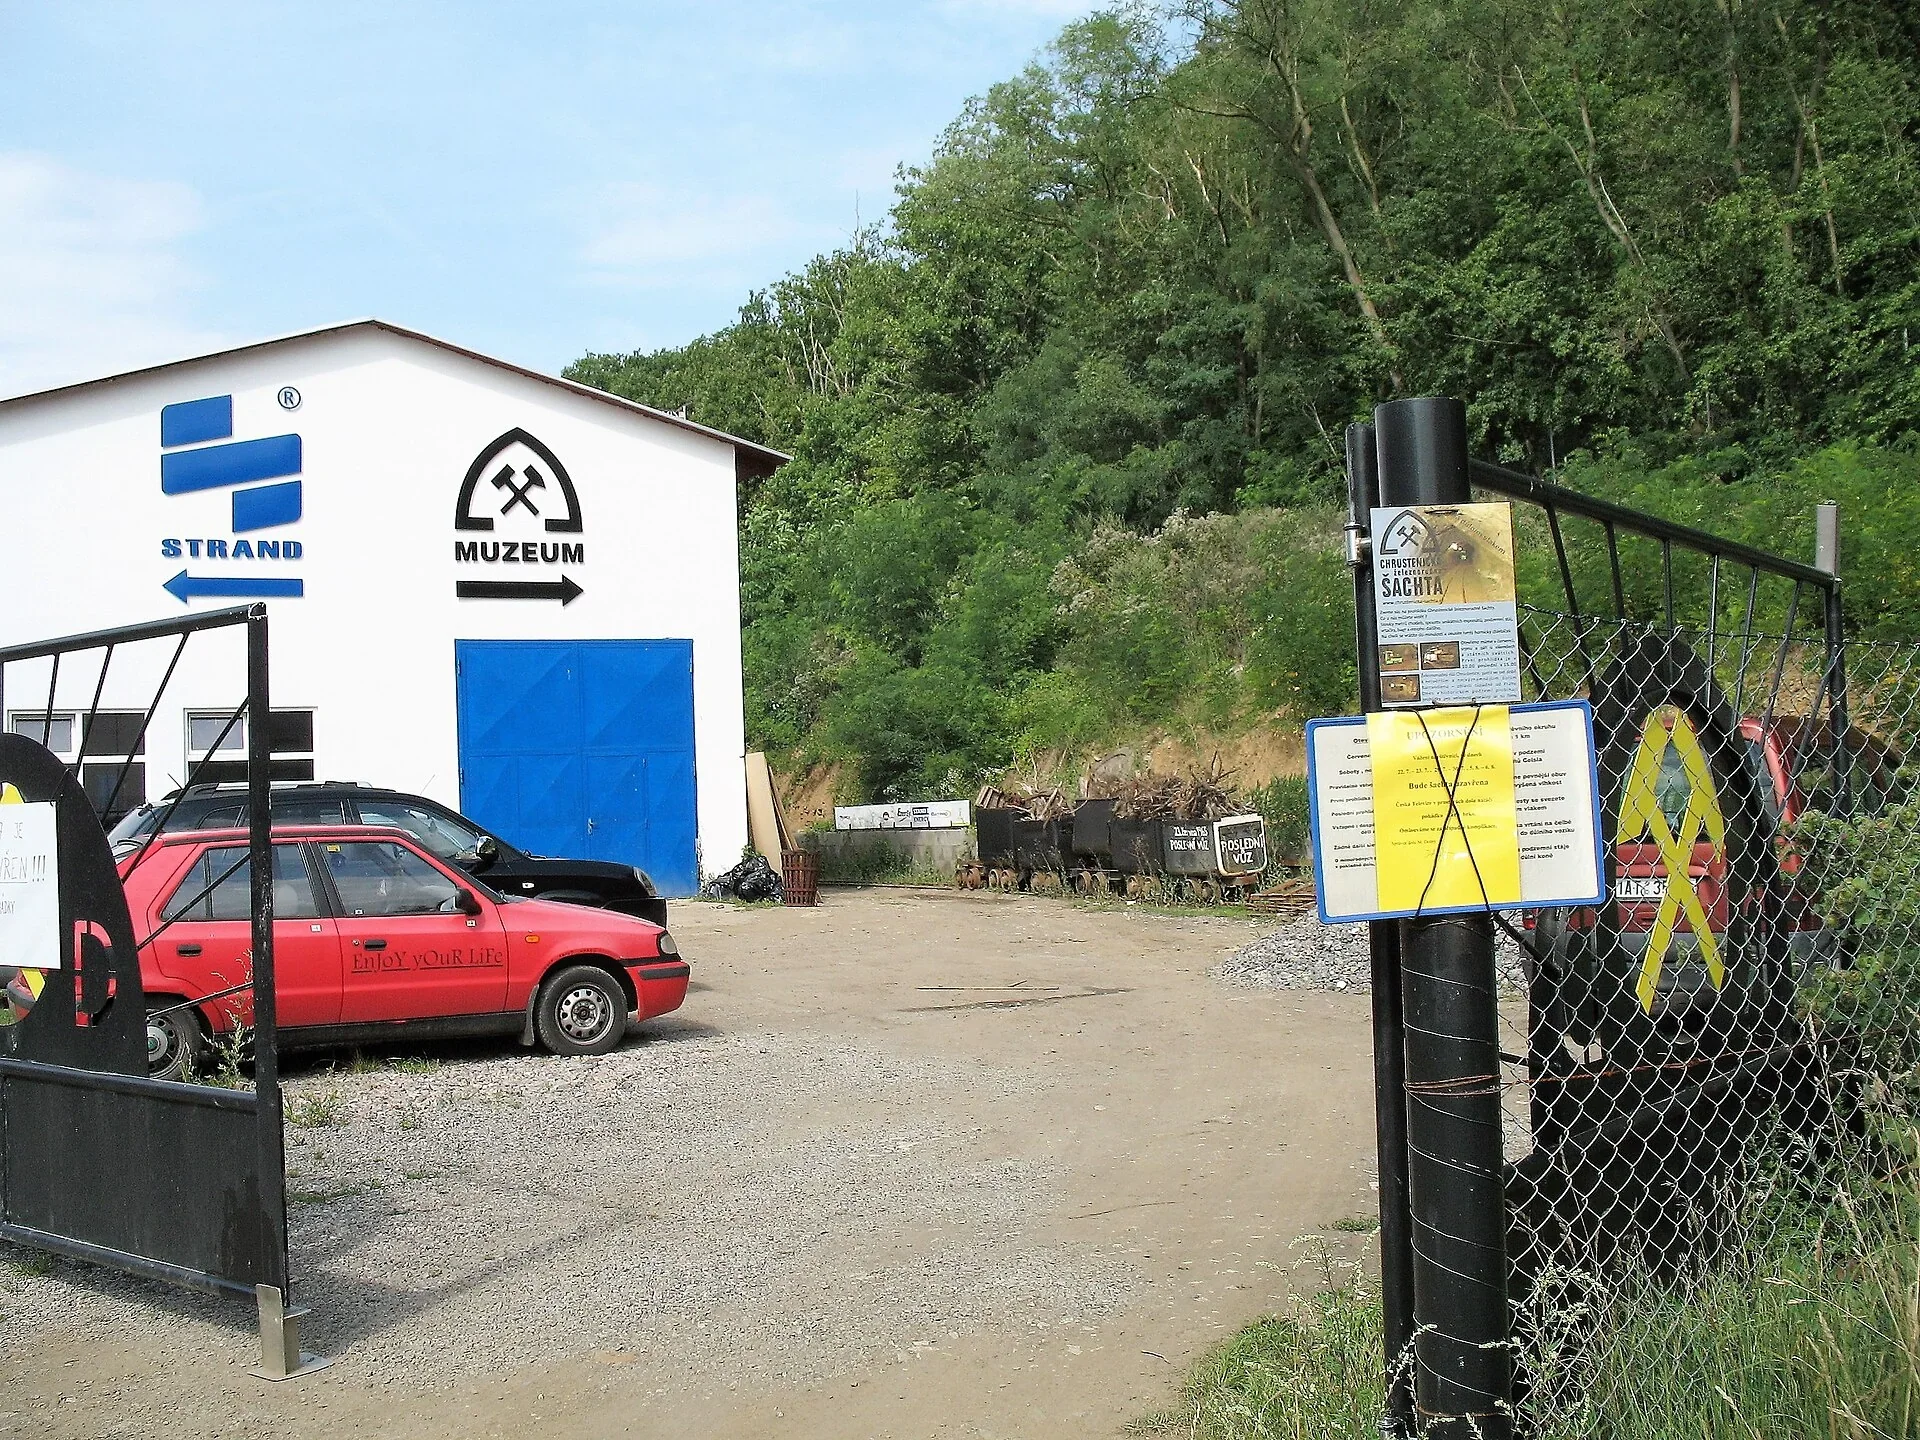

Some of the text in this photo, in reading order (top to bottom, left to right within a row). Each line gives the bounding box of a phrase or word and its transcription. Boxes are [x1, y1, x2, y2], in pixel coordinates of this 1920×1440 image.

[161, 538, 303, 560] STRAND
[455, 540, 584, 563] MUZEUM
[1381, 572, 1444, 598] ŠACHTA
[1533, 723, 1556, 731] okruhu
[1408, 782, 1427, 790] Bude
[14, 821, 23, 839] JE
